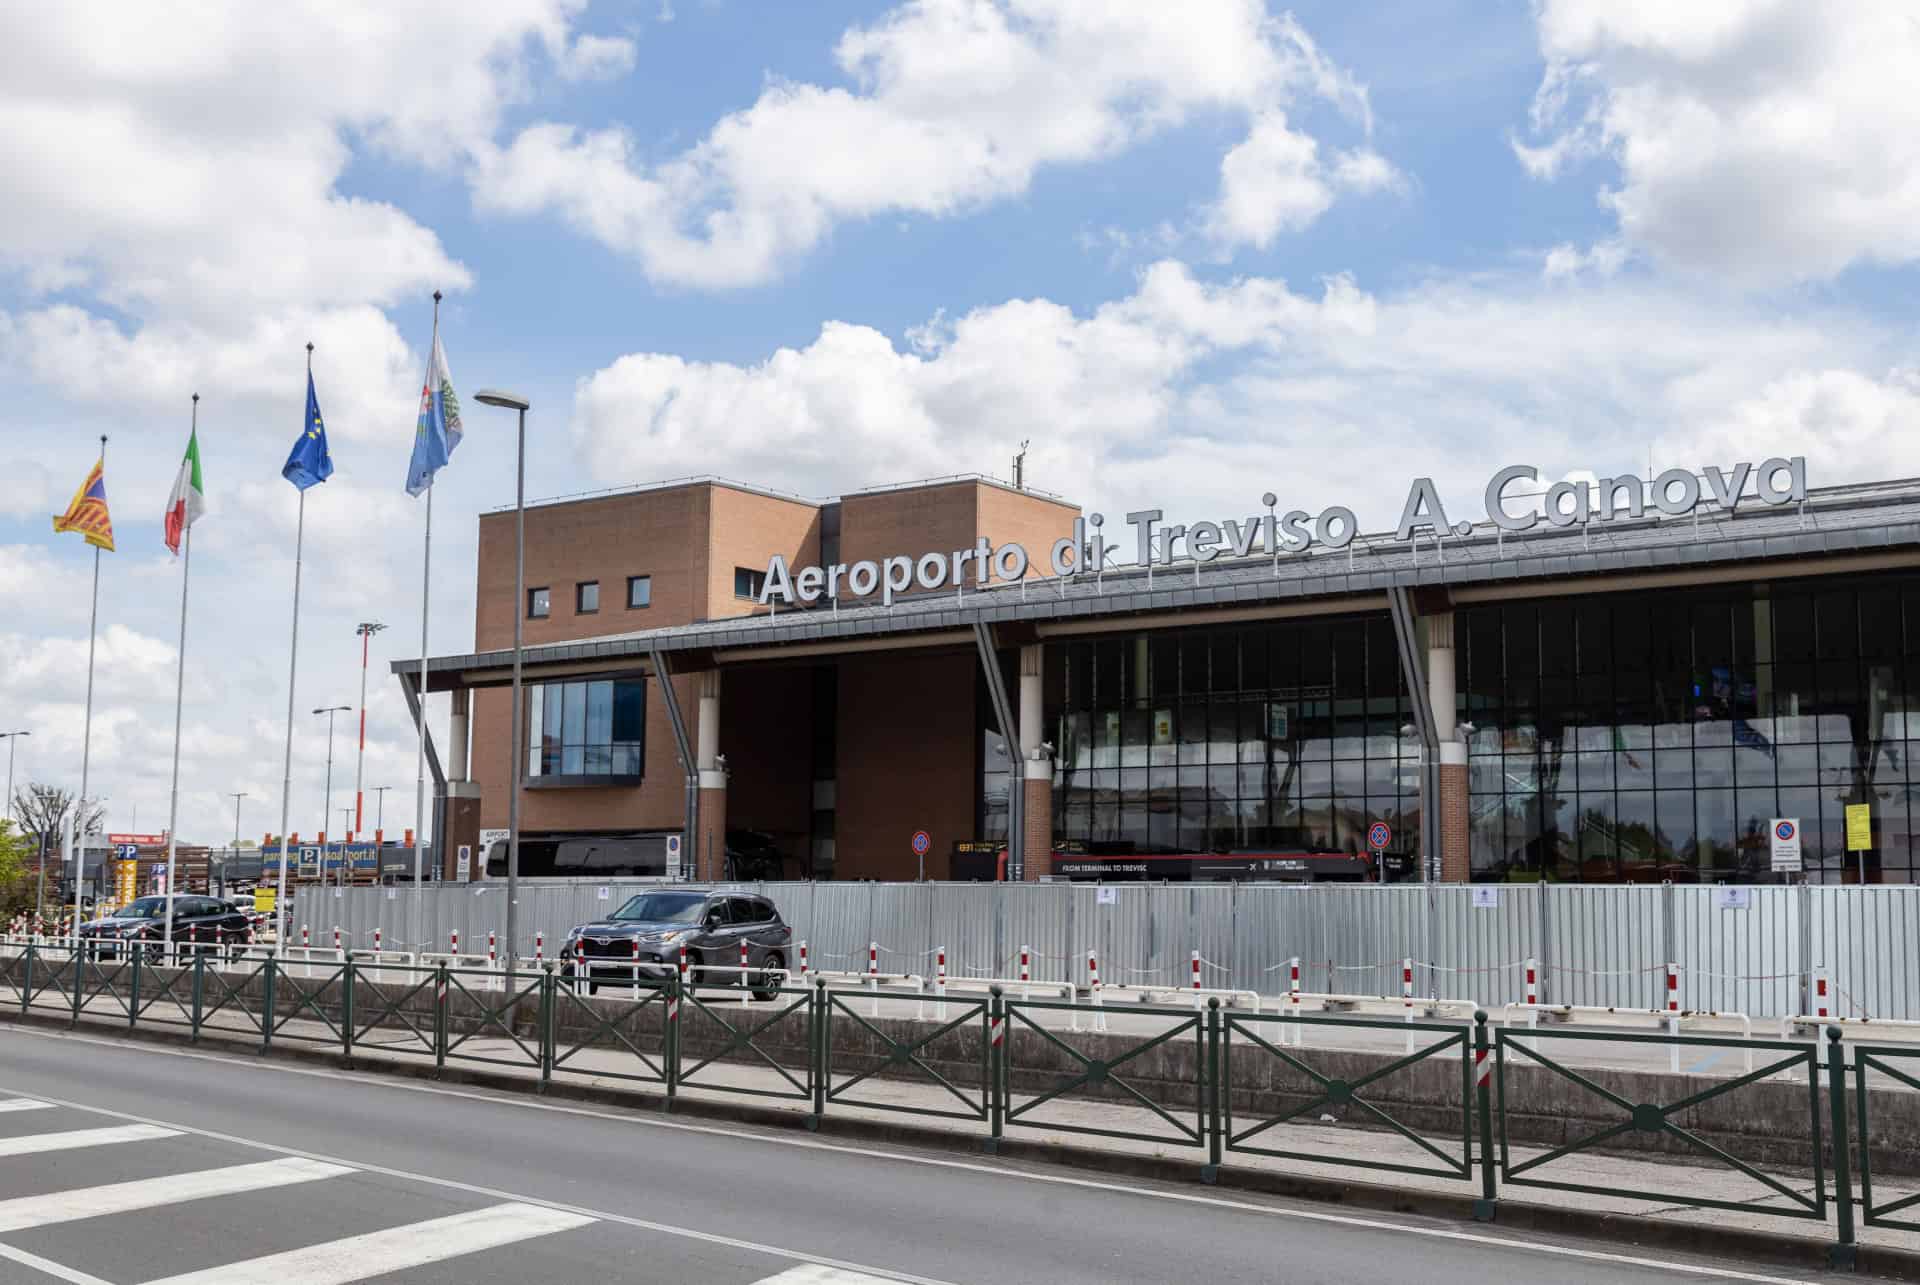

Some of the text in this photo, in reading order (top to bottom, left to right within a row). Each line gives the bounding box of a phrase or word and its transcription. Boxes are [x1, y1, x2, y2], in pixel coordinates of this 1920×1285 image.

[759, 456, 1807, 607] Aeroporto di Treviso A. Canova
[126, 846, 136, 859] P
[304, 849, 314, 861] P
